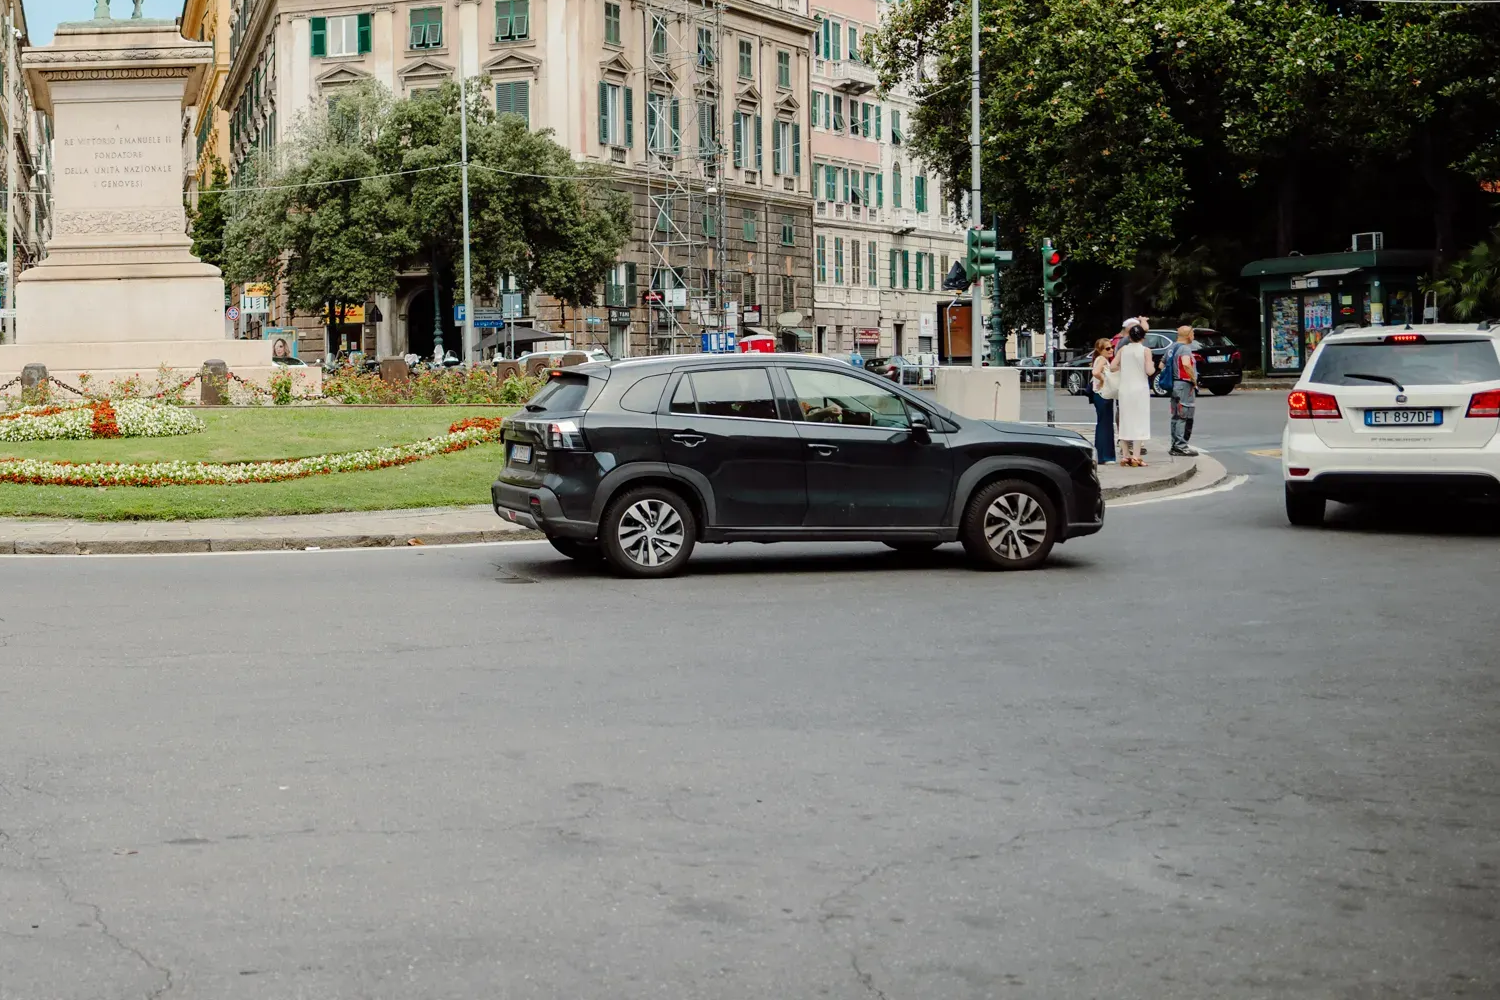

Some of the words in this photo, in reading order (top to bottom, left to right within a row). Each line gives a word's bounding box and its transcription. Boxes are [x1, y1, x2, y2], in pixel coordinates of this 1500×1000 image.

[64, 138, 74, 146] RE
[78, 137, 116, 146] VITTORIO
[120, 136, 161, 145] EMANUELE
[94, 151, 143, 160] FONDATORE
[64, 167, 89, 175] DELLA
[94, 165, 120, 174] UNITÀ
[124, 165, 172, 174] NAZIONALE
[101, 180, 143, 188] GENOVESI
[1373, 411, 1389, 423] ET
[1393, 411, 1433, 423] 897DF
